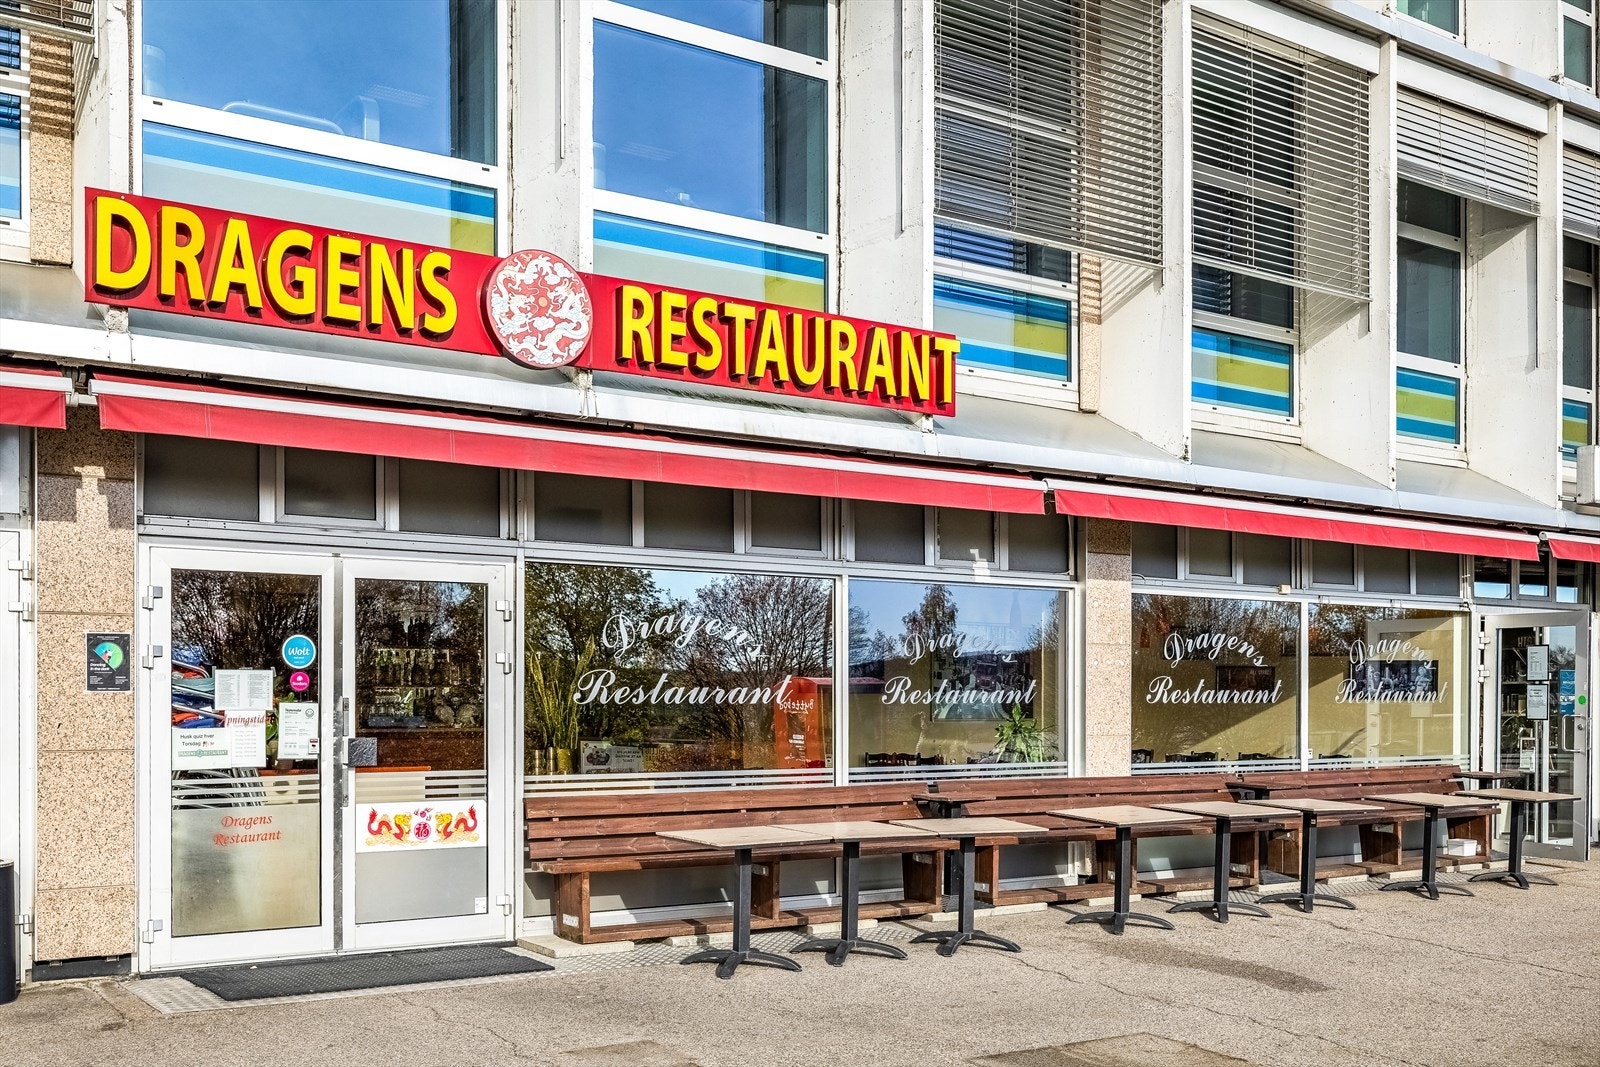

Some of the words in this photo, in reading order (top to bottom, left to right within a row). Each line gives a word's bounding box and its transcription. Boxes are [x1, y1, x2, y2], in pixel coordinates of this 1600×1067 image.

[94, 196, 458, 336] DRAGENS
[617, 285, 961, 405] RESTAURANT
[288, 647, 310, 656] Wolt
[601, 610, 768, 661] Dragens
[904, 631, 1018, 665] Dragens
[1164, 630, 1269, 669] Dragens
[1349, 637, 1437, 672] Dragens
[573, 668, 794, 706] Restaurant
[882, 675, 1038, 705] Restaurant
[1146, 675, 1283, 704] Restaurant
[1335, 678, 1448, 704] Restaurant
[214, 830, 282, 846] Restaurant
[221, 815, 273, 830] Dragens
